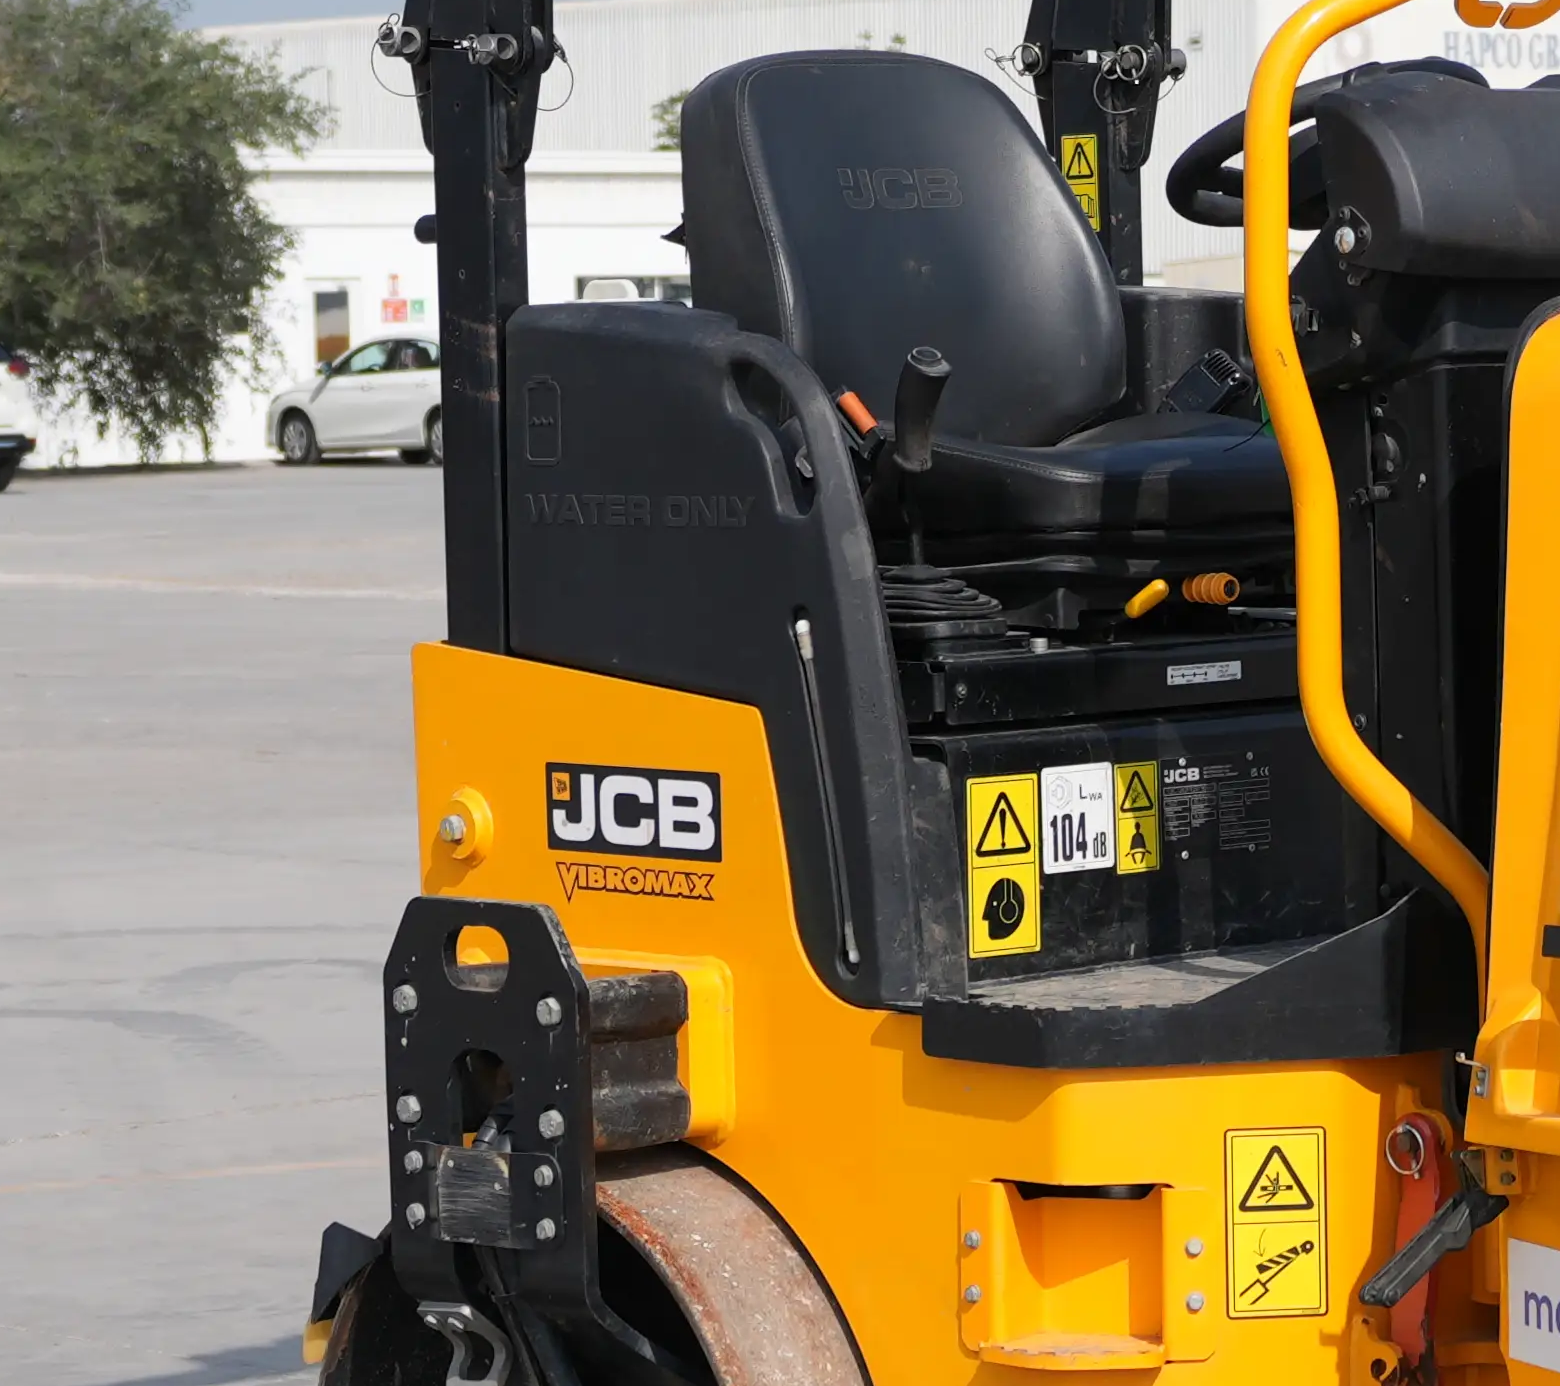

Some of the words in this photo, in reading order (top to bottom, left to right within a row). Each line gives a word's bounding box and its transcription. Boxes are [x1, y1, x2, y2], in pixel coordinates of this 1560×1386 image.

[1442, 30, 1523, 67] HAPCO
[836, 168, 963, 209] JCB
[524, 493, 651, 526] WATER
[664, 494, 756, 528] ONLY
[1164, 767, 1200, 784] JCB
[551, 772, 716, 851] JCB
[1050, 812, 1088, 863] 104
[555, 861, 716, 904] VIBROMAX
